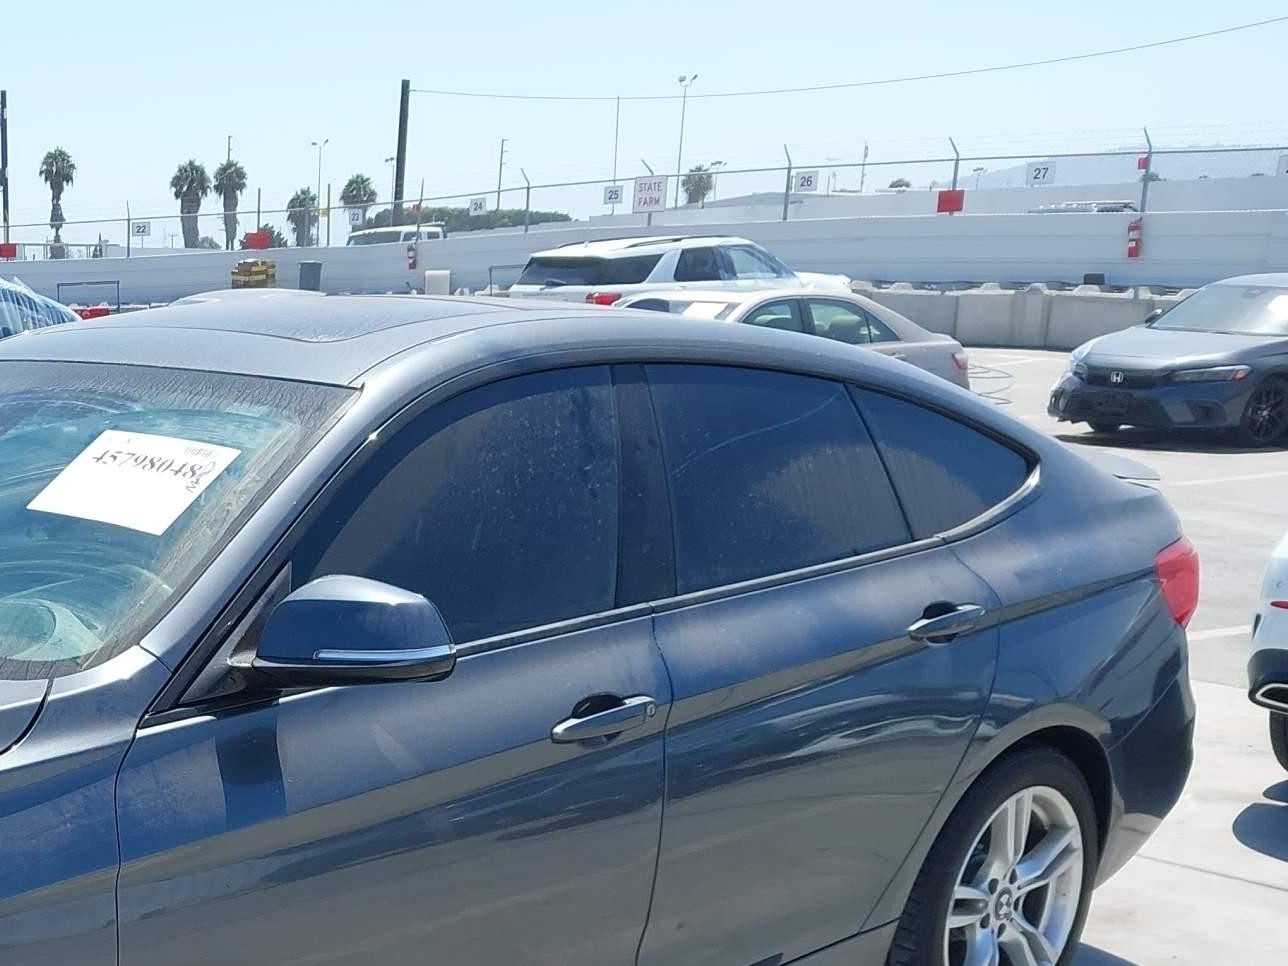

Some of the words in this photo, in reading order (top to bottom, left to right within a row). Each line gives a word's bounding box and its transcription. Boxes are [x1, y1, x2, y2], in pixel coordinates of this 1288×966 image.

[1033, 167, 1049, 180] 27
[638, 181, 663, 193] STATE
[800, 176, 813, 187] 26
[608, 190, 619, 200] 25
[473, 202, 483, 211] 24
[638, 196, 661, 207] FARM
[136, 225, 147, 233] 22
[92, 449, 203, 480] 45798048
